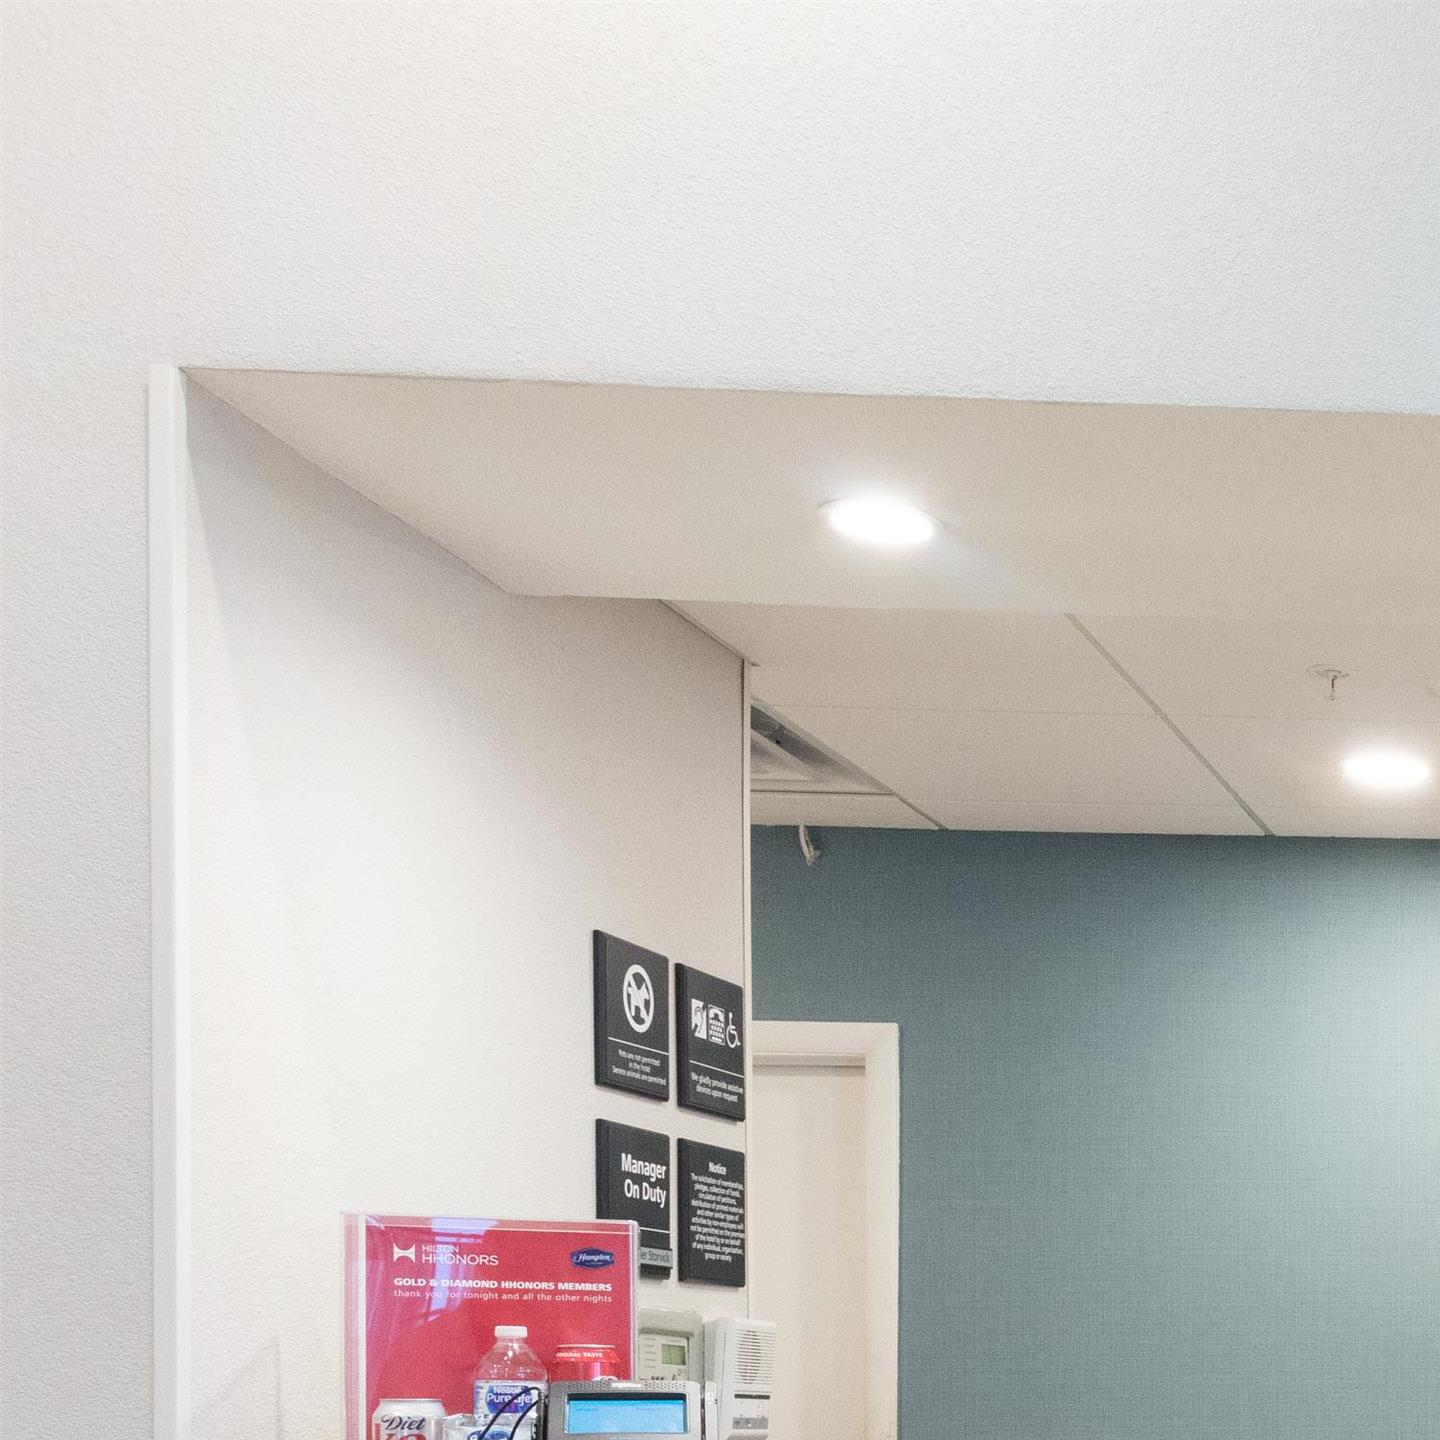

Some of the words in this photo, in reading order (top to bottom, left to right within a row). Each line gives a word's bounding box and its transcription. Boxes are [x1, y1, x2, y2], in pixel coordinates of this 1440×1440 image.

[621, 1152, 667, 1183] Manager
[624, 1178, 640, 1199] On
[642, 1182, 667, 1208] Duty
[421, 1244, 460, 1253] HILTON
[421, 1253, 499, 1266] HHONORS
[576, 1251, 612, 1264] Hampton
[393, 1277, 427, 1288] GOLD
[429, 1278, 438, 1288] &
[440, 1278, 499, 1289] DIAMOND
[500, 1280, 556, 1291] HHONORS
[557, 1282, 613, 1292] MEMBERS
[393, 1289, 422, 1299] thank
[425, 1291, 444, 1300] you
[446, 1290, 462, 1299] for
[463, 1291, 499, 1302] tonight
[501, 1292, 520, 1301] and
[522, 1292, 535, 1301] all
[536, 1293, 553, 1302] the
[555, 1293, 580, 1303] other
[583, 1294, 613, 1304] nights
[381, 1414, 427, 1431] Diet
